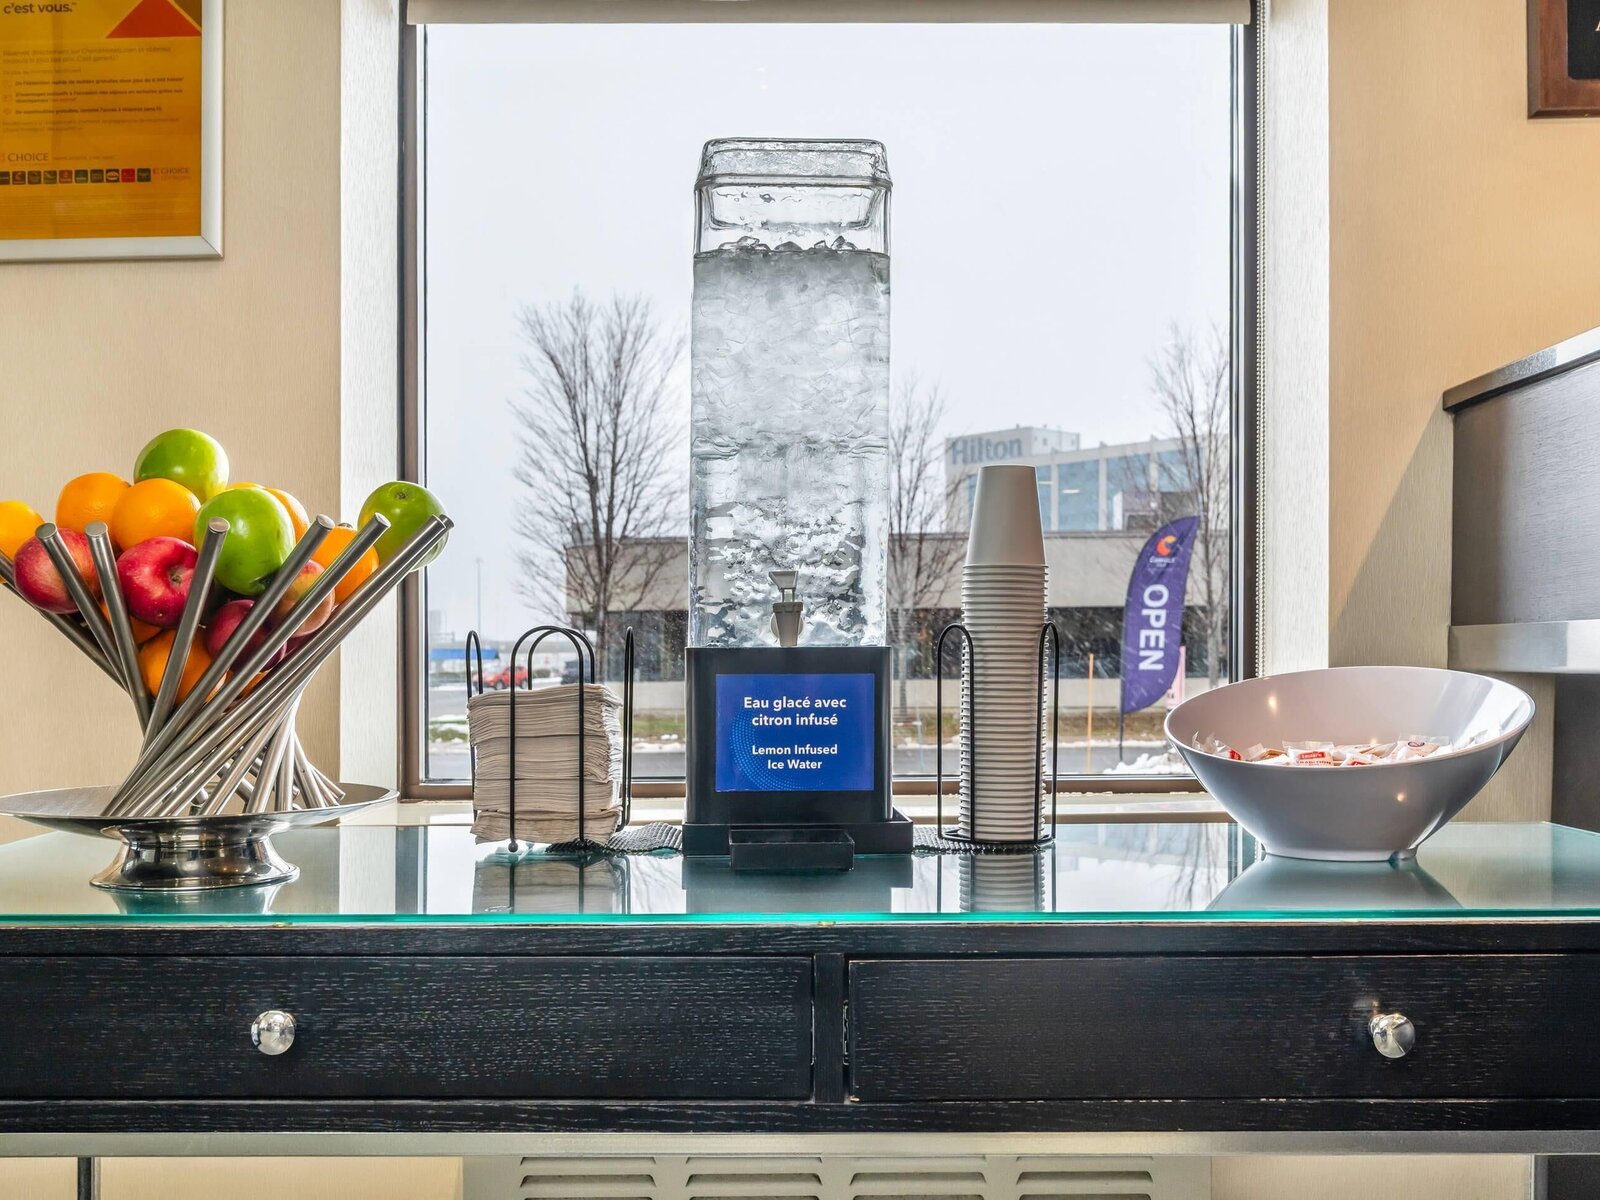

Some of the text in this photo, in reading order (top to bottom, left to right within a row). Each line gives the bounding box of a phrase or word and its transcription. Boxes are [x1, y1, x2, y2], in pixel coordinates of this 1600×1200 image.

[3, 2, 34, 14] c'est
[8, 152, 49, 162] CHOICE
[951, 435, 1022, 465] Hilton
[1138, 583, 1170, 672] OPEN
[743, 696, 847, 711] Eau glacé avec
[751, 713, 839, 726] citron infusé
[752, 744, 838, 755] Lemon Infused
[767, 759, 823, 769] Ice Water
